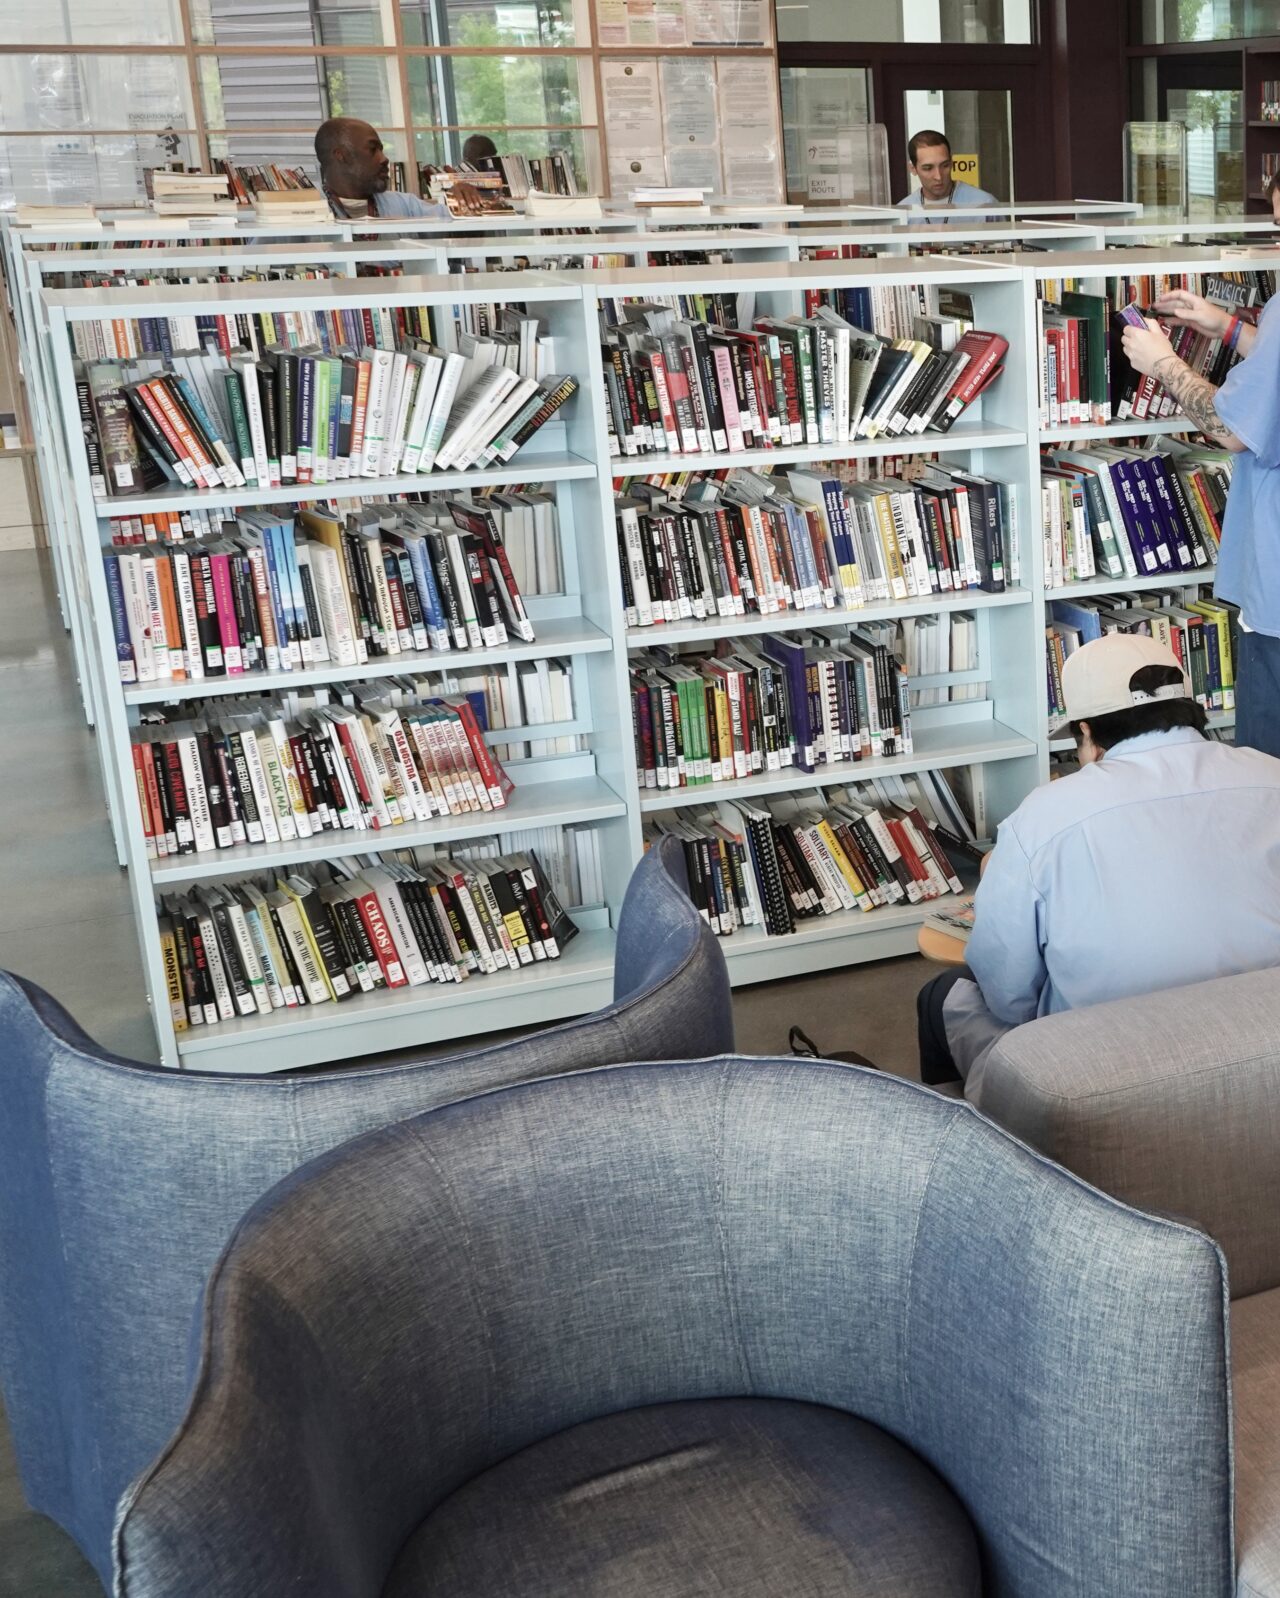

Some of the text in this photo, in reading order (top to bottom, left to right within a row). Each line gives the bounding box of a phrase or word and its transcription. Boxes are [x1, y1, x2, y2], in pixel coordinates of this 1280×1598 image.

[953, 160, 976, 172] TOP
[612, 352, 623, 375] RUSE
[820, 331, 830, 406] MASTER THIEVES
[229, 378, 240, 397] SILENT
[655, 366, 670, 416] JAMES PATTERSON
[705, 356, 718, 406] Violent Offenders
[736, 378, 745, 400] Redemption
[745, 371, 757, 416] JAMES PATTERSO
[803, 365, 816, 423] BIG DIRTY MO
[232, 398, 244, 421] SPRING
[354, 372, 367, 454] ON FIRE NAOMI KLEI
[530, 381, 576, 426] UNPRECEDENTED
[826, 493, 834, 510] Mapping
[831, 492, 839, 510] Mapping
[837, 492, 846, 510] Mapping
[988, 498, 997, 527] Rikers
[1170, 474, 1199, 548] PATHWAY TO RENEWA
[681, 517, 690, 532] Captured
[879, 499, 898, 569] THE MASTER PLAN CHRIS
[930, 518, 941, 551] EAR HUSTLE
[180, 564, 189, 578] JANE
[672, 561, 681, 570] LIFE
[674, 572, 683, 586] AFTER
[146, 571, 160, 627] HOMEGROWN HATE
[182, 582, 192, 603] FONDA
[191, 559, 208, 619] THE CLIMATE BOOK
[201, 557, 216, 613] GRETA THUNBERG
[677, 587, 685, 598] DEA
[109, 564, 124, 638] Our Fragile Moment
[185, 608, 195, 626] WHAT
[188, 628, 197, 641] CAN
[731, 702, 741, 720] STAND
[1056, 691, 1064, 711] COLLEGE
[662, 689, 676, 757] AMERICAN PURGATORY
[369, 743, 386, 775] GANGBUSTER
[382, 748, 399, 777] AMERICAN
[189, 741, 208, 822] SHADOW OF MY FATHER
[235, 757, 250, 792] REDEEMED
[268, 762, 289, 817] BLACK MAS
[795, 832, 815, 862] SOLITARY
[808, 831, 830, 860] SOLITARY
[865, 834, 882, 858] SOLITARY
[735, 869, 744, 887] HUSTLE
[483, 885, 497, 910] BANDITS
[365, 901, 389, 946] CHAOS
[388, 897, 410, 948] AMERICAN HOMICIDE
[165, 948, 180, 1000] MONSTER
